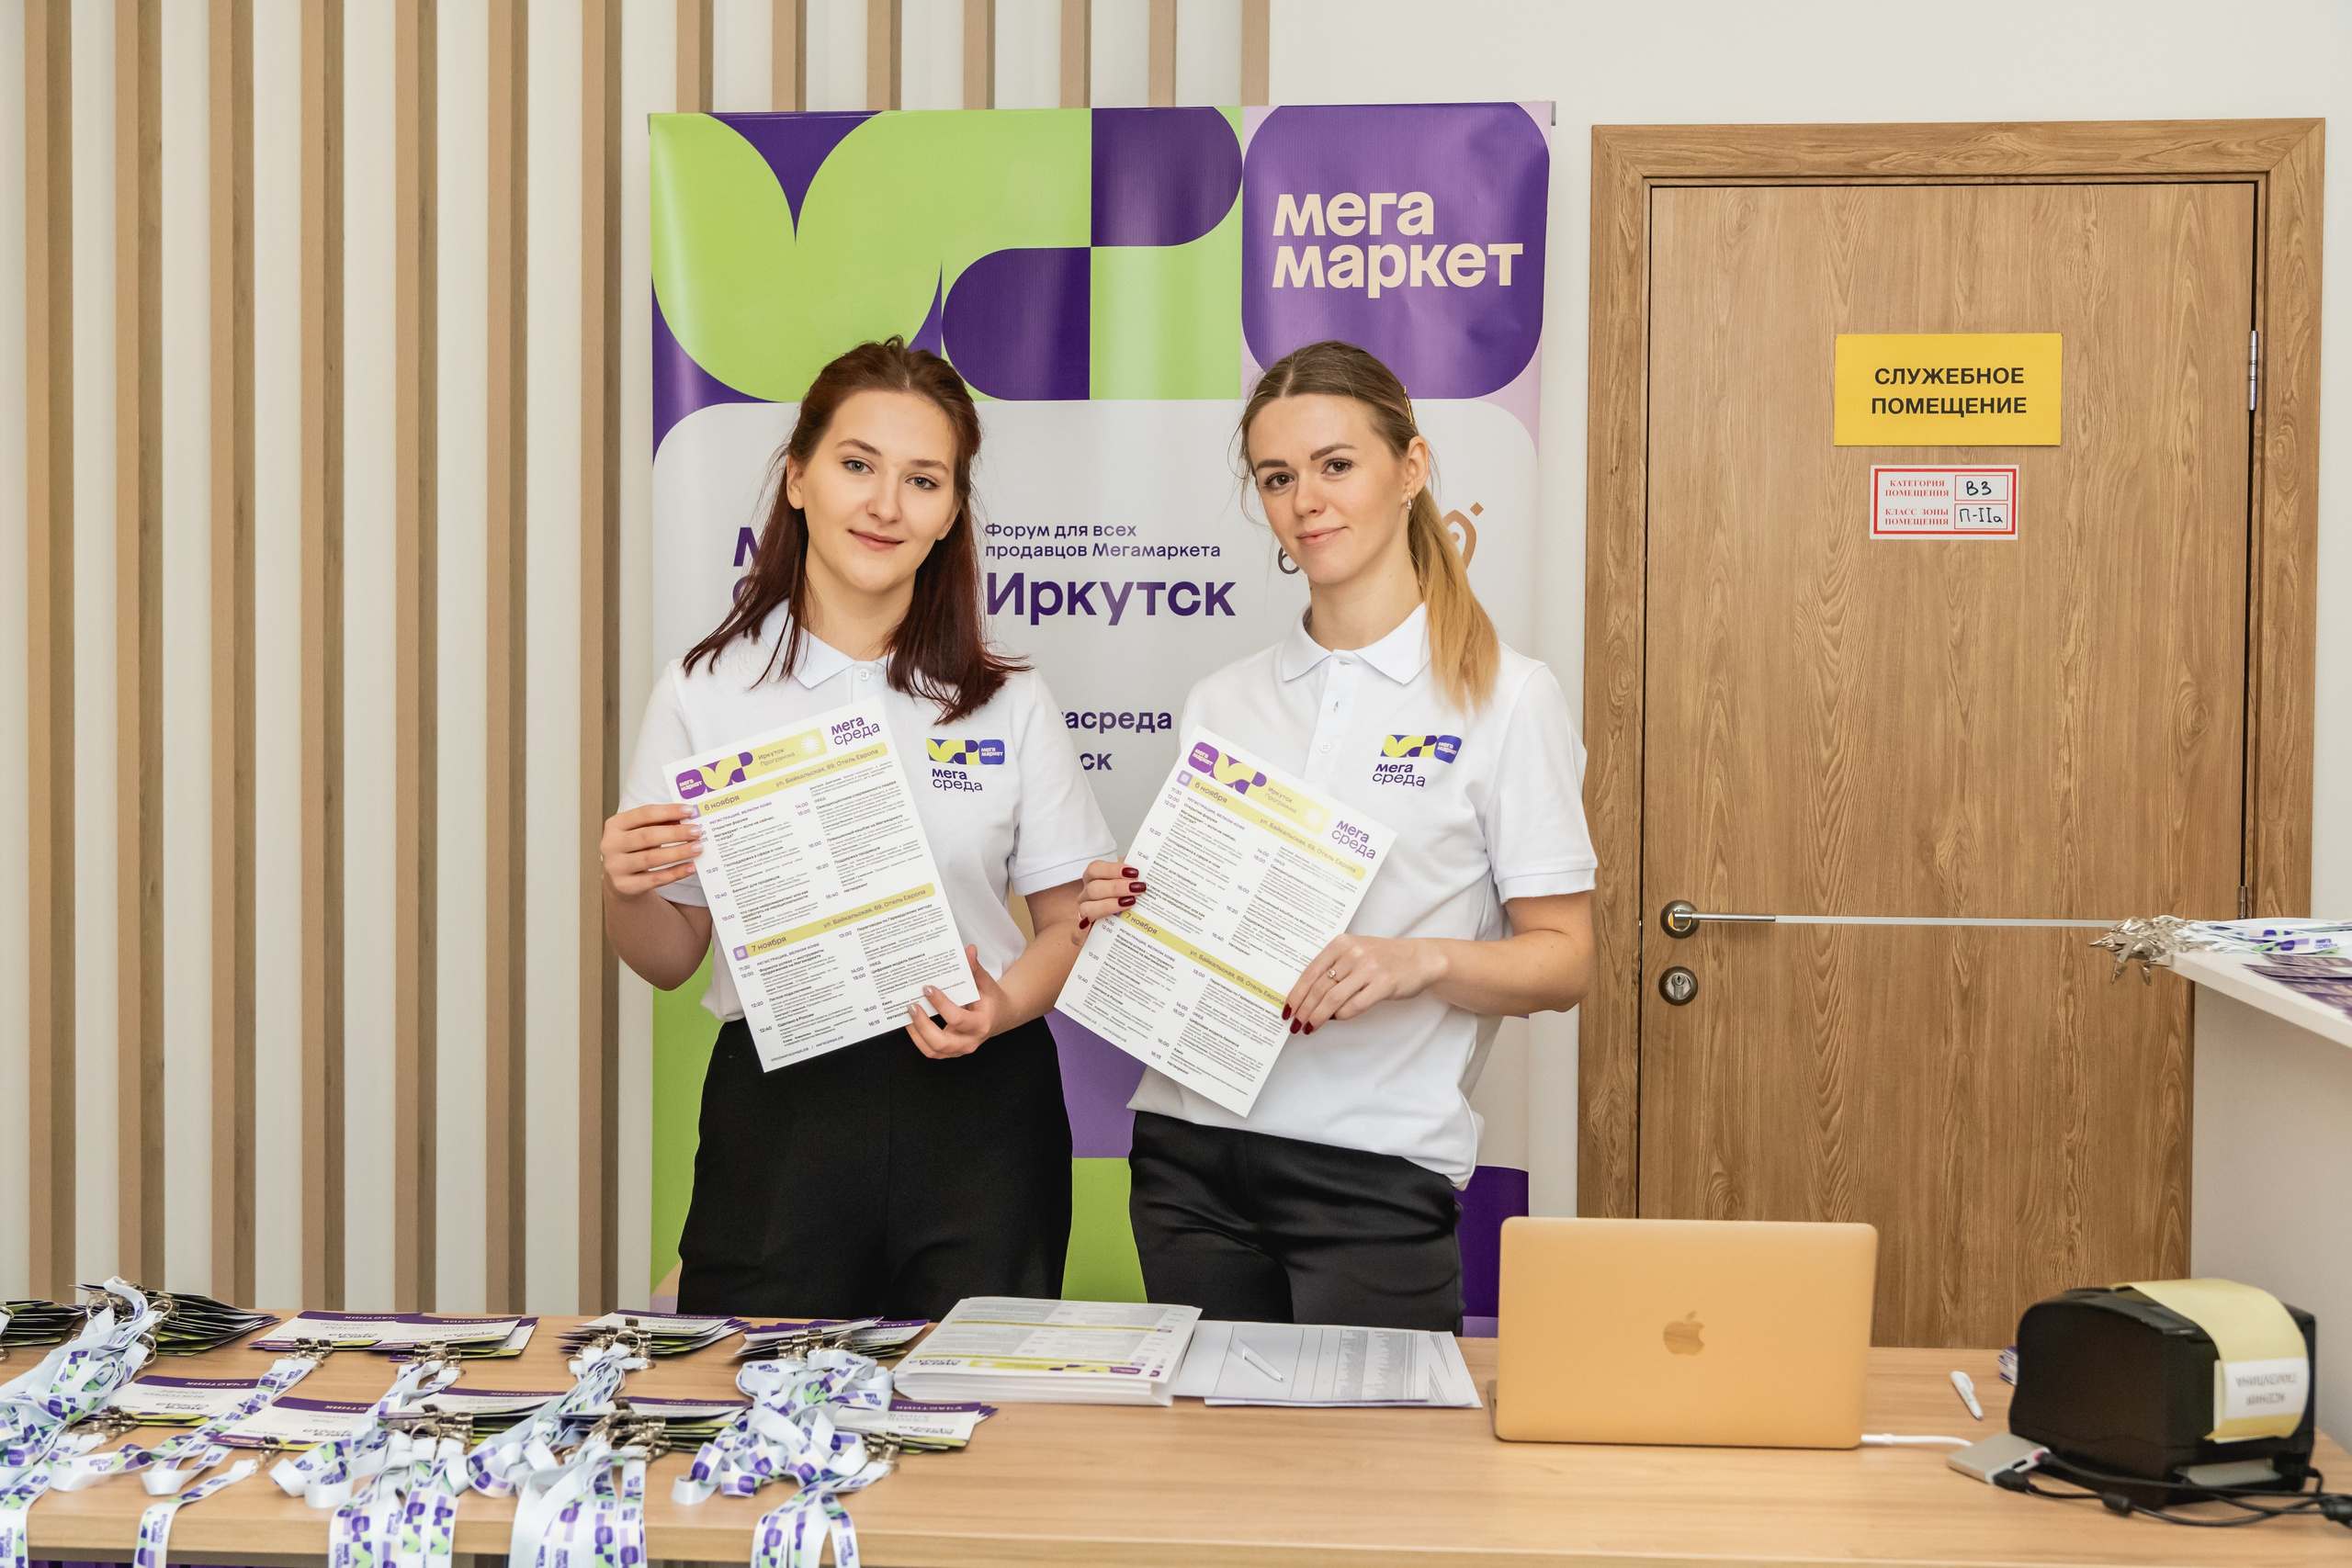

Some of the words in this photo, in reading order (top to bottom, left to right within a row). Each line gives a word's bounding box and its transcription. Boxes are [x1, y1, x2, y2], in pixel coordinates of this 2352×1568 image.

[1272, 191, 1434, 237] мега
[1272, 243, 1524, 299] маркет
[1874, 367, 2025, 385] СЛУЖЕБНОЕ
[1871, 397, 2027, 418] ПОМЕЩЕНИЕ
[1890, 479, 1945, 488] КАТЕГОРИЯ
[1885, 489, 1950, 498] ПОМЕЩЕНИЯ
[1885, 517, 1949, 526] ПОМЕЩЕНИЯ
[985, 523, 1050, 539] Форум
[1054, 525, 1088, 539] для
[1093, 525, 1136, 537] всех
[985, 544, 1088, 560] продавцов
[1092, 543, 1221, 560] Мегамаркета
[987, 572, 1237, 626] Иркутск
[831, 716, 865, 735] мега
[834, 723, 880, 745] среда
[758, 749, 785, 760] Иркутск
[760, 752, 796, 767] Программа
[785, 768, 826, 784] Байкальская,
[836, 758, 856, 766] Отель
[856, 750, 878, 760] Европа
[932, 768, 967, 781] мега
[1375, 763, 1413, 773] мега
[933, 778, 983, 793] среда
[1372, 773, 1426, 788] среда
[711, 795, 740, 808] ноября
[1200, 786, 1227, 804] ноября
[1268, 786, 1292, 803] Иркутск
[1264, 793, 1296, 814] Программа
[1336, 820, 1369, 843] мега
[1269, 822, 1306, 846] Байкальская,
[1307, 843, 1316, 852] 69,
[1317, 849, 1334, 862] Отель
[1335, 859, 1356, 874] Европа
[1332, 830, 1376, 860] среда
[832, 908, 873, 925] Байкальская,
[884, 898, 903, 908] Отель
[903, 890, 926, 901] Европа
[1131, 917, 1158, 934] ноября
[758, 937, 786, 950] ноября
[1198, 954, 1235, 979] Байкальская,
[1246, 981, 1262, 994] Отель
[1263, 990, 1286, 1005] Европа
